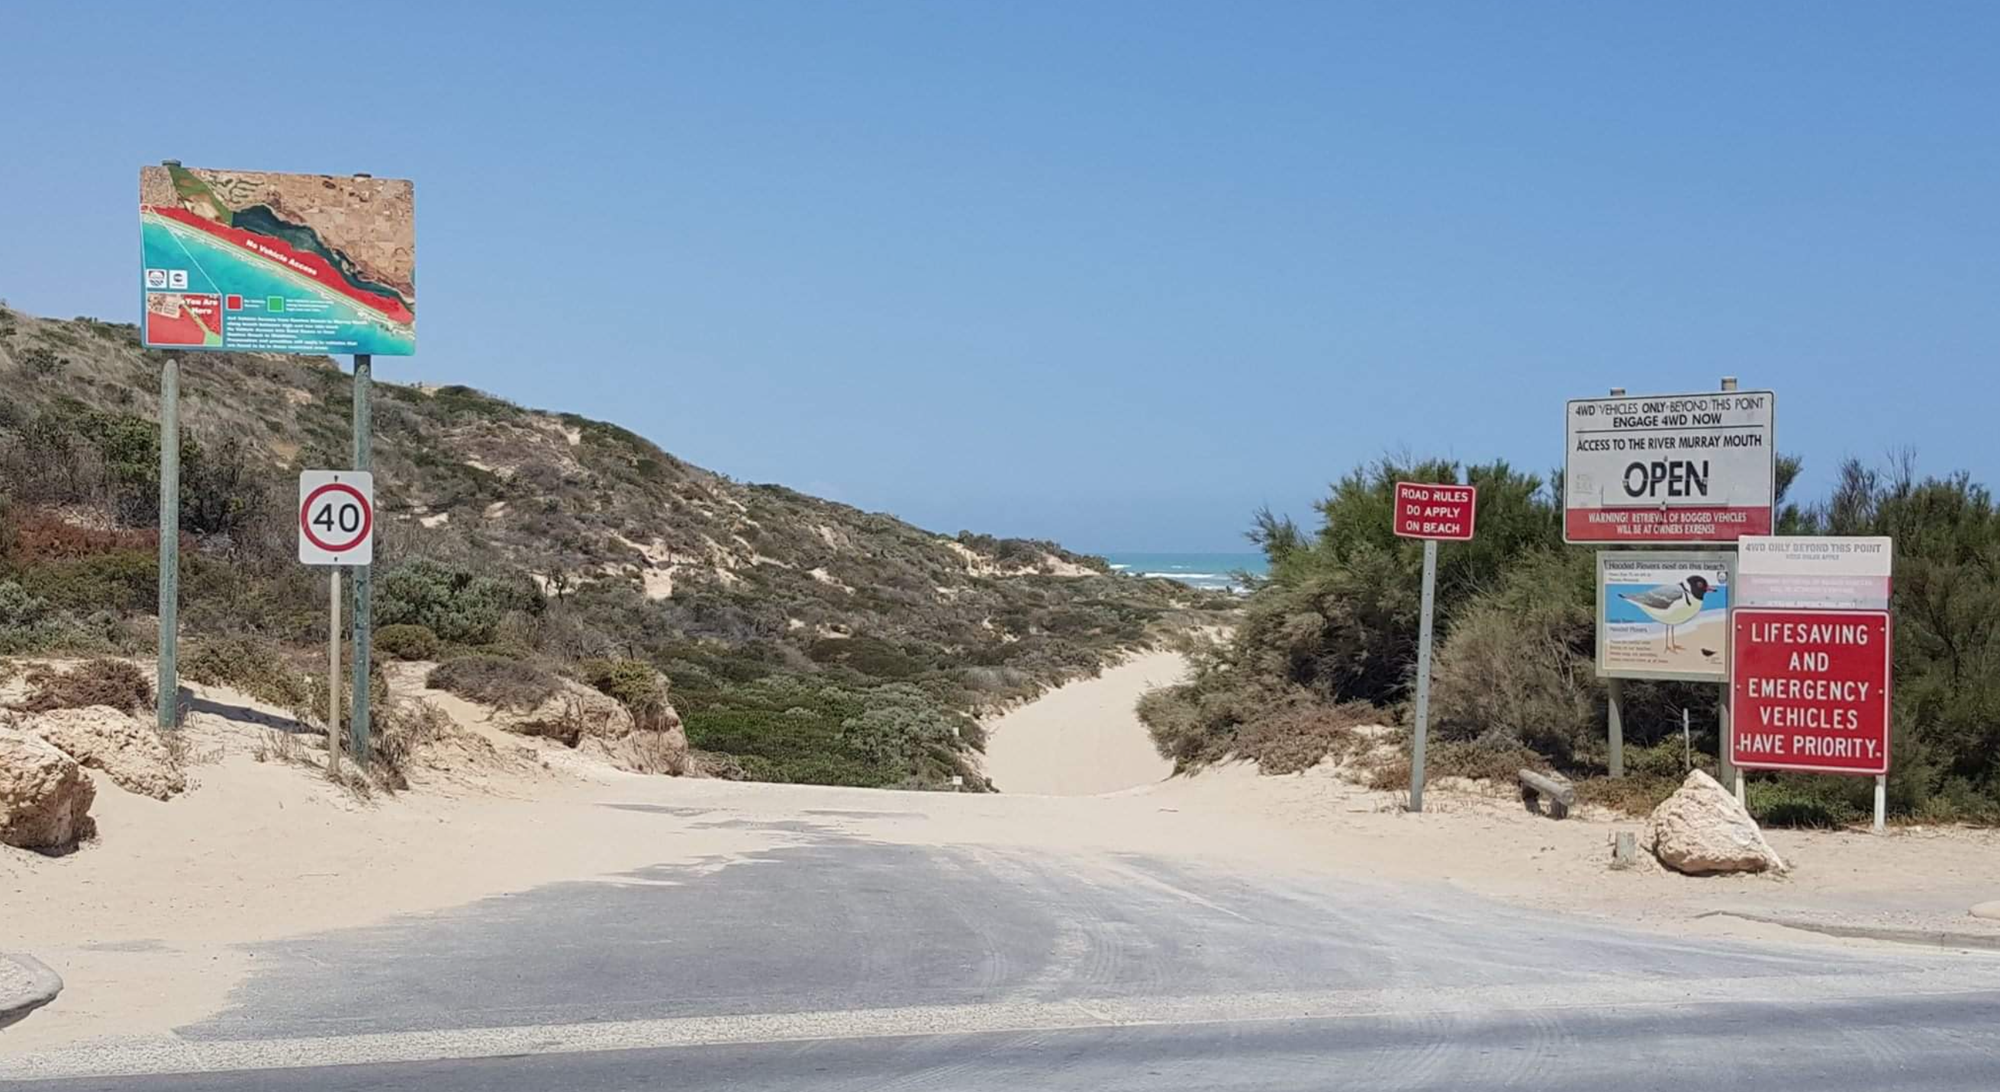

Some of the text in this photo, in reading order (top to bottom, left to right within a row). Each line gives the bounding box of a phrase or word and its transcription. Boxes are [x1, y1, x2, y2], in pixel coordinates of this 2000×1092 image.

[259, 244, 288, 263] Vehicle
[288, 258, 318, 276] Access
[1575, 397, 1764, 416] 4WD VEHICLES ONLY BEYOND THIS POINT
[1612, 413, 1722, 428] ENGAGE 4WD NOW
[1576, 434, 1762, 452] ACCESS TO THE RIVER MURRAY MOUTH
[1622, 460, 1709, 498] OPEN
[1401, 488, 1469, 502] ROAD RULES
[312, 503, 360, 533] 40
[1406, 504, 1461, 518] DO APPLY
[1588, 512, 1747, 523] WARNING! RETRIEVAL OF BOGGED VEHICLES
[1405, 520, 1460, 534] ON BEACH
[1616, 525, 1632, 534] WILL
[1633, 525, 1642, 534] BE
[1643, 525, 1652, 534] AT
[1653, 524, 1683, 535] OWNERS
[1745, 543, 1882, 554] 4WD ONLY BEYOND THIS POINT
[1751, 622, 1869, 646] LIFESAVING
[1789, 651, 1830, 672] AND
[1748, 677, 1870, 702] EMERGENCY
[1759, 705, 1859, 730] VEHICLES
[1739, 732, 1786, 755] HAVE
